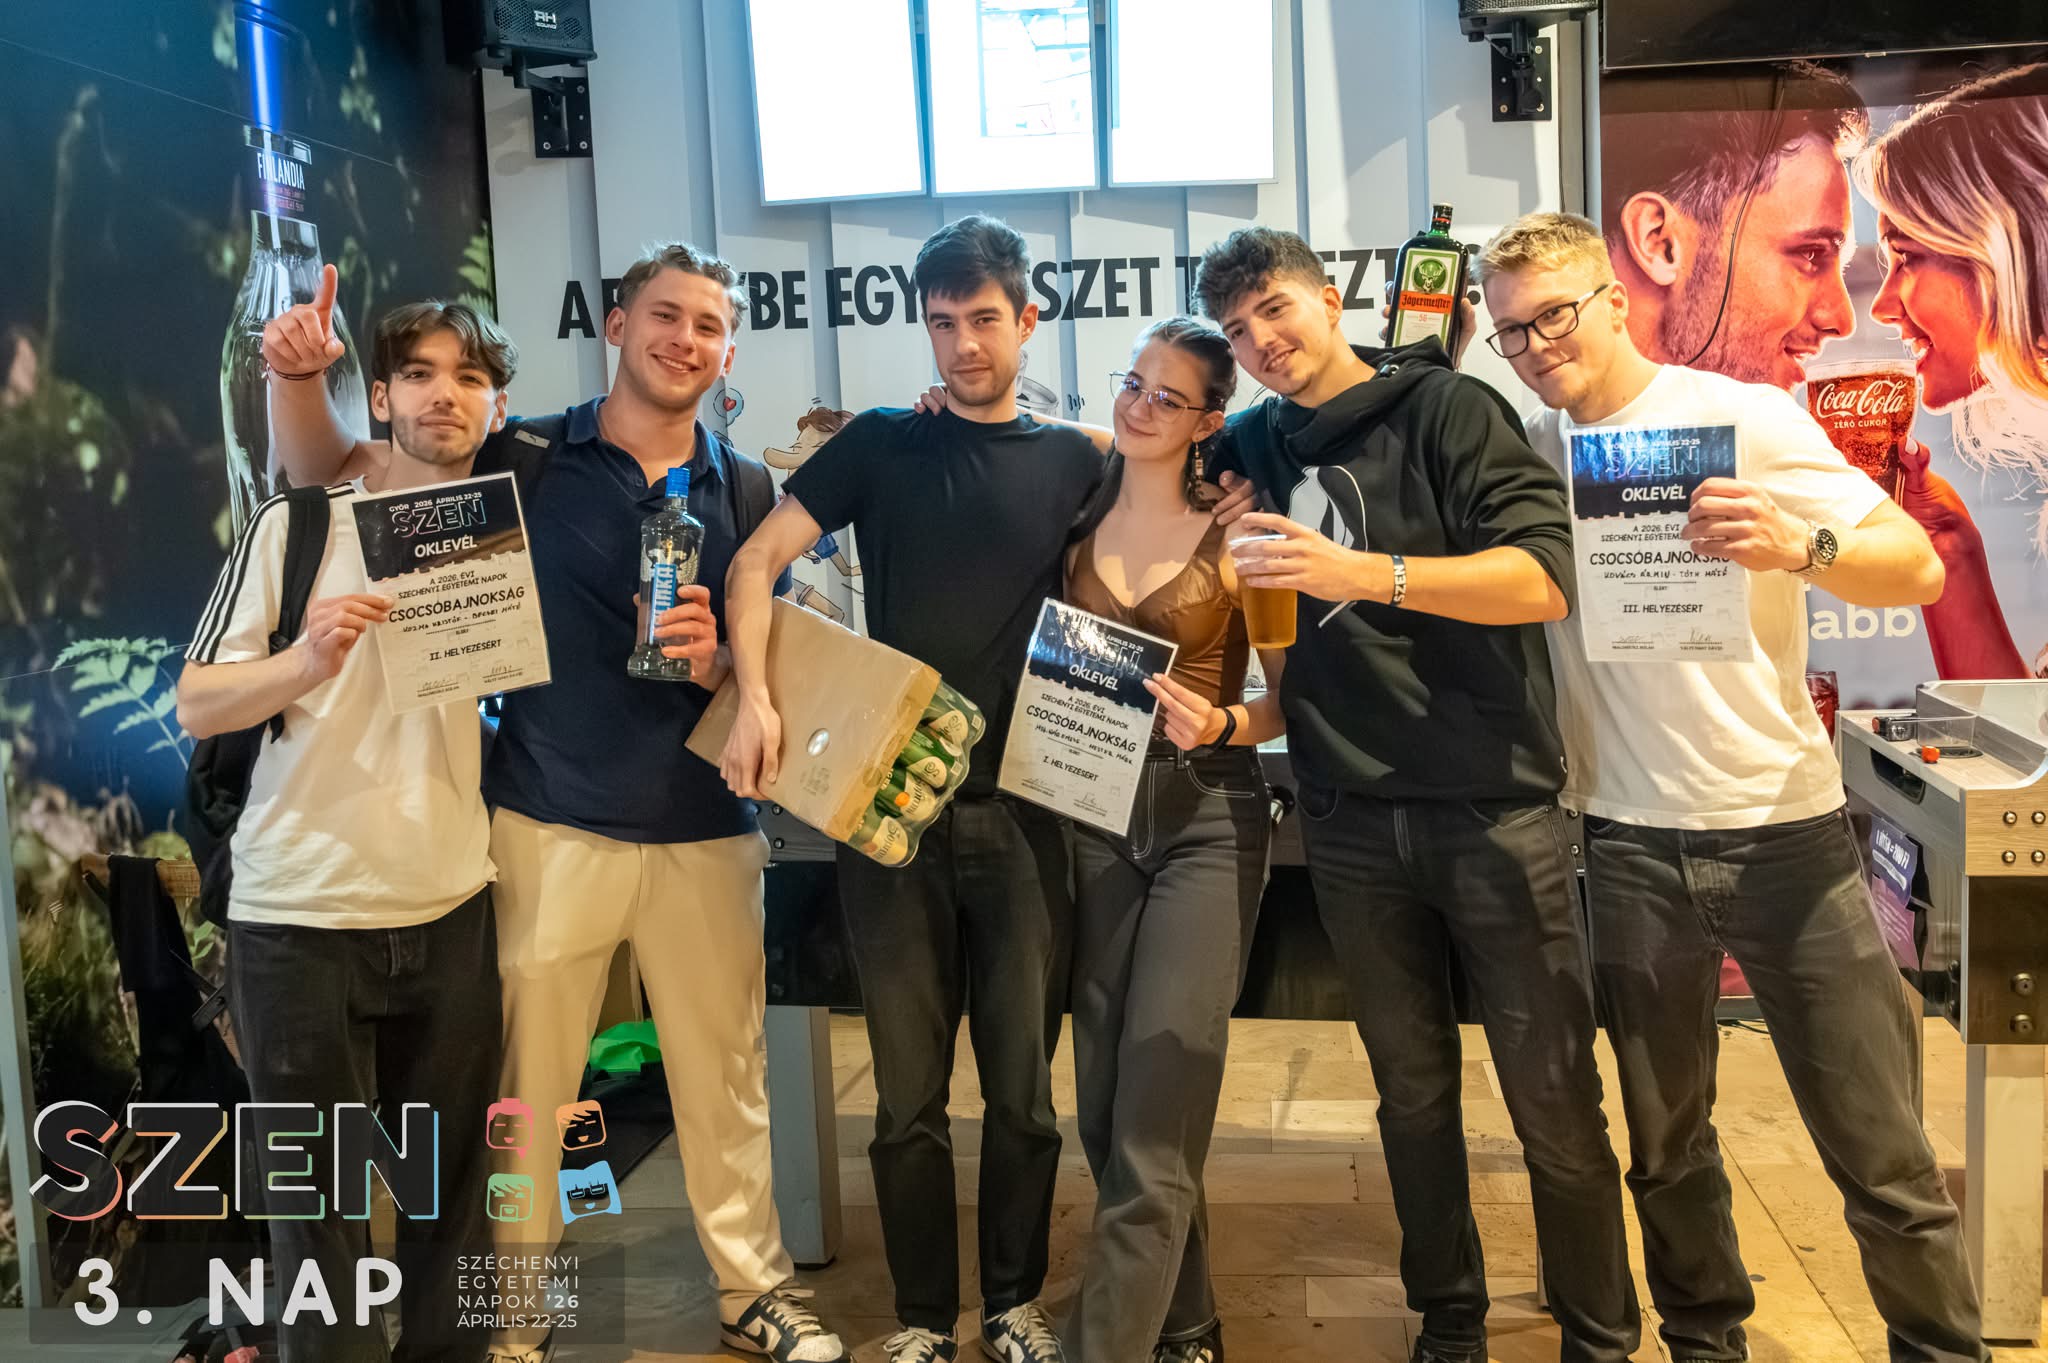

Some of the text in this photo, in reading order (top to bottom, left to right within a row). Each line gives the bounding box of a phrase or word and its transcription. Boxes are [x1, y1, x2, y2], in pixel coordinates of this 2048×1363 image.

[257, 152, 305, 190] FINLANDIA
[558, 281, 596, 339] A
[825, 265, 919, 329] EGY
[1816, 379, 1907, 418] Coca-Cola
[1858, 418, 1887, 428] CUKOR
[414, 499, 433, 508] 2026
[436, 494, 463, 504] ÁPRILIS
[464, 492, 482, 500] 22-25
[1622, 484, 1687, 502] OKLEVÉL
[391, 498, 487, 538] SZEN
[1665, 524, 1680, 532] ÉVI
[414, 534, 477, 558] OKLEVÉL
[1601, 533, 1642, 542] SZÉCHENYI
[398, 572, 508, 599] SZÉCHENYI EGYETEMI NAPOK
[460, 570, 475, 579] ÉVI
[1393, 564, 1406, 604] SZEN
[388, 586, 525, 623] CSOCSÓBAJNOKSÁG
[1642, 603, 1703, 613] HELYEZÉSÉRT
[444, 639, 502, 658] HELYEZÉSÉRT
[1128, 642, 1144, 652] 22-25
[1069, 664, 1119, 691] OKLEVÉL
[1026, 704, 1137, 753] CSOCSÓBAJNOKSÁG
[1075, 706, 1105, 722] EGYETEMI
[1106, 716, 1129, 730] NAPOK
[1050, 759, 1099, 782] HELYEZÉSÉRT
